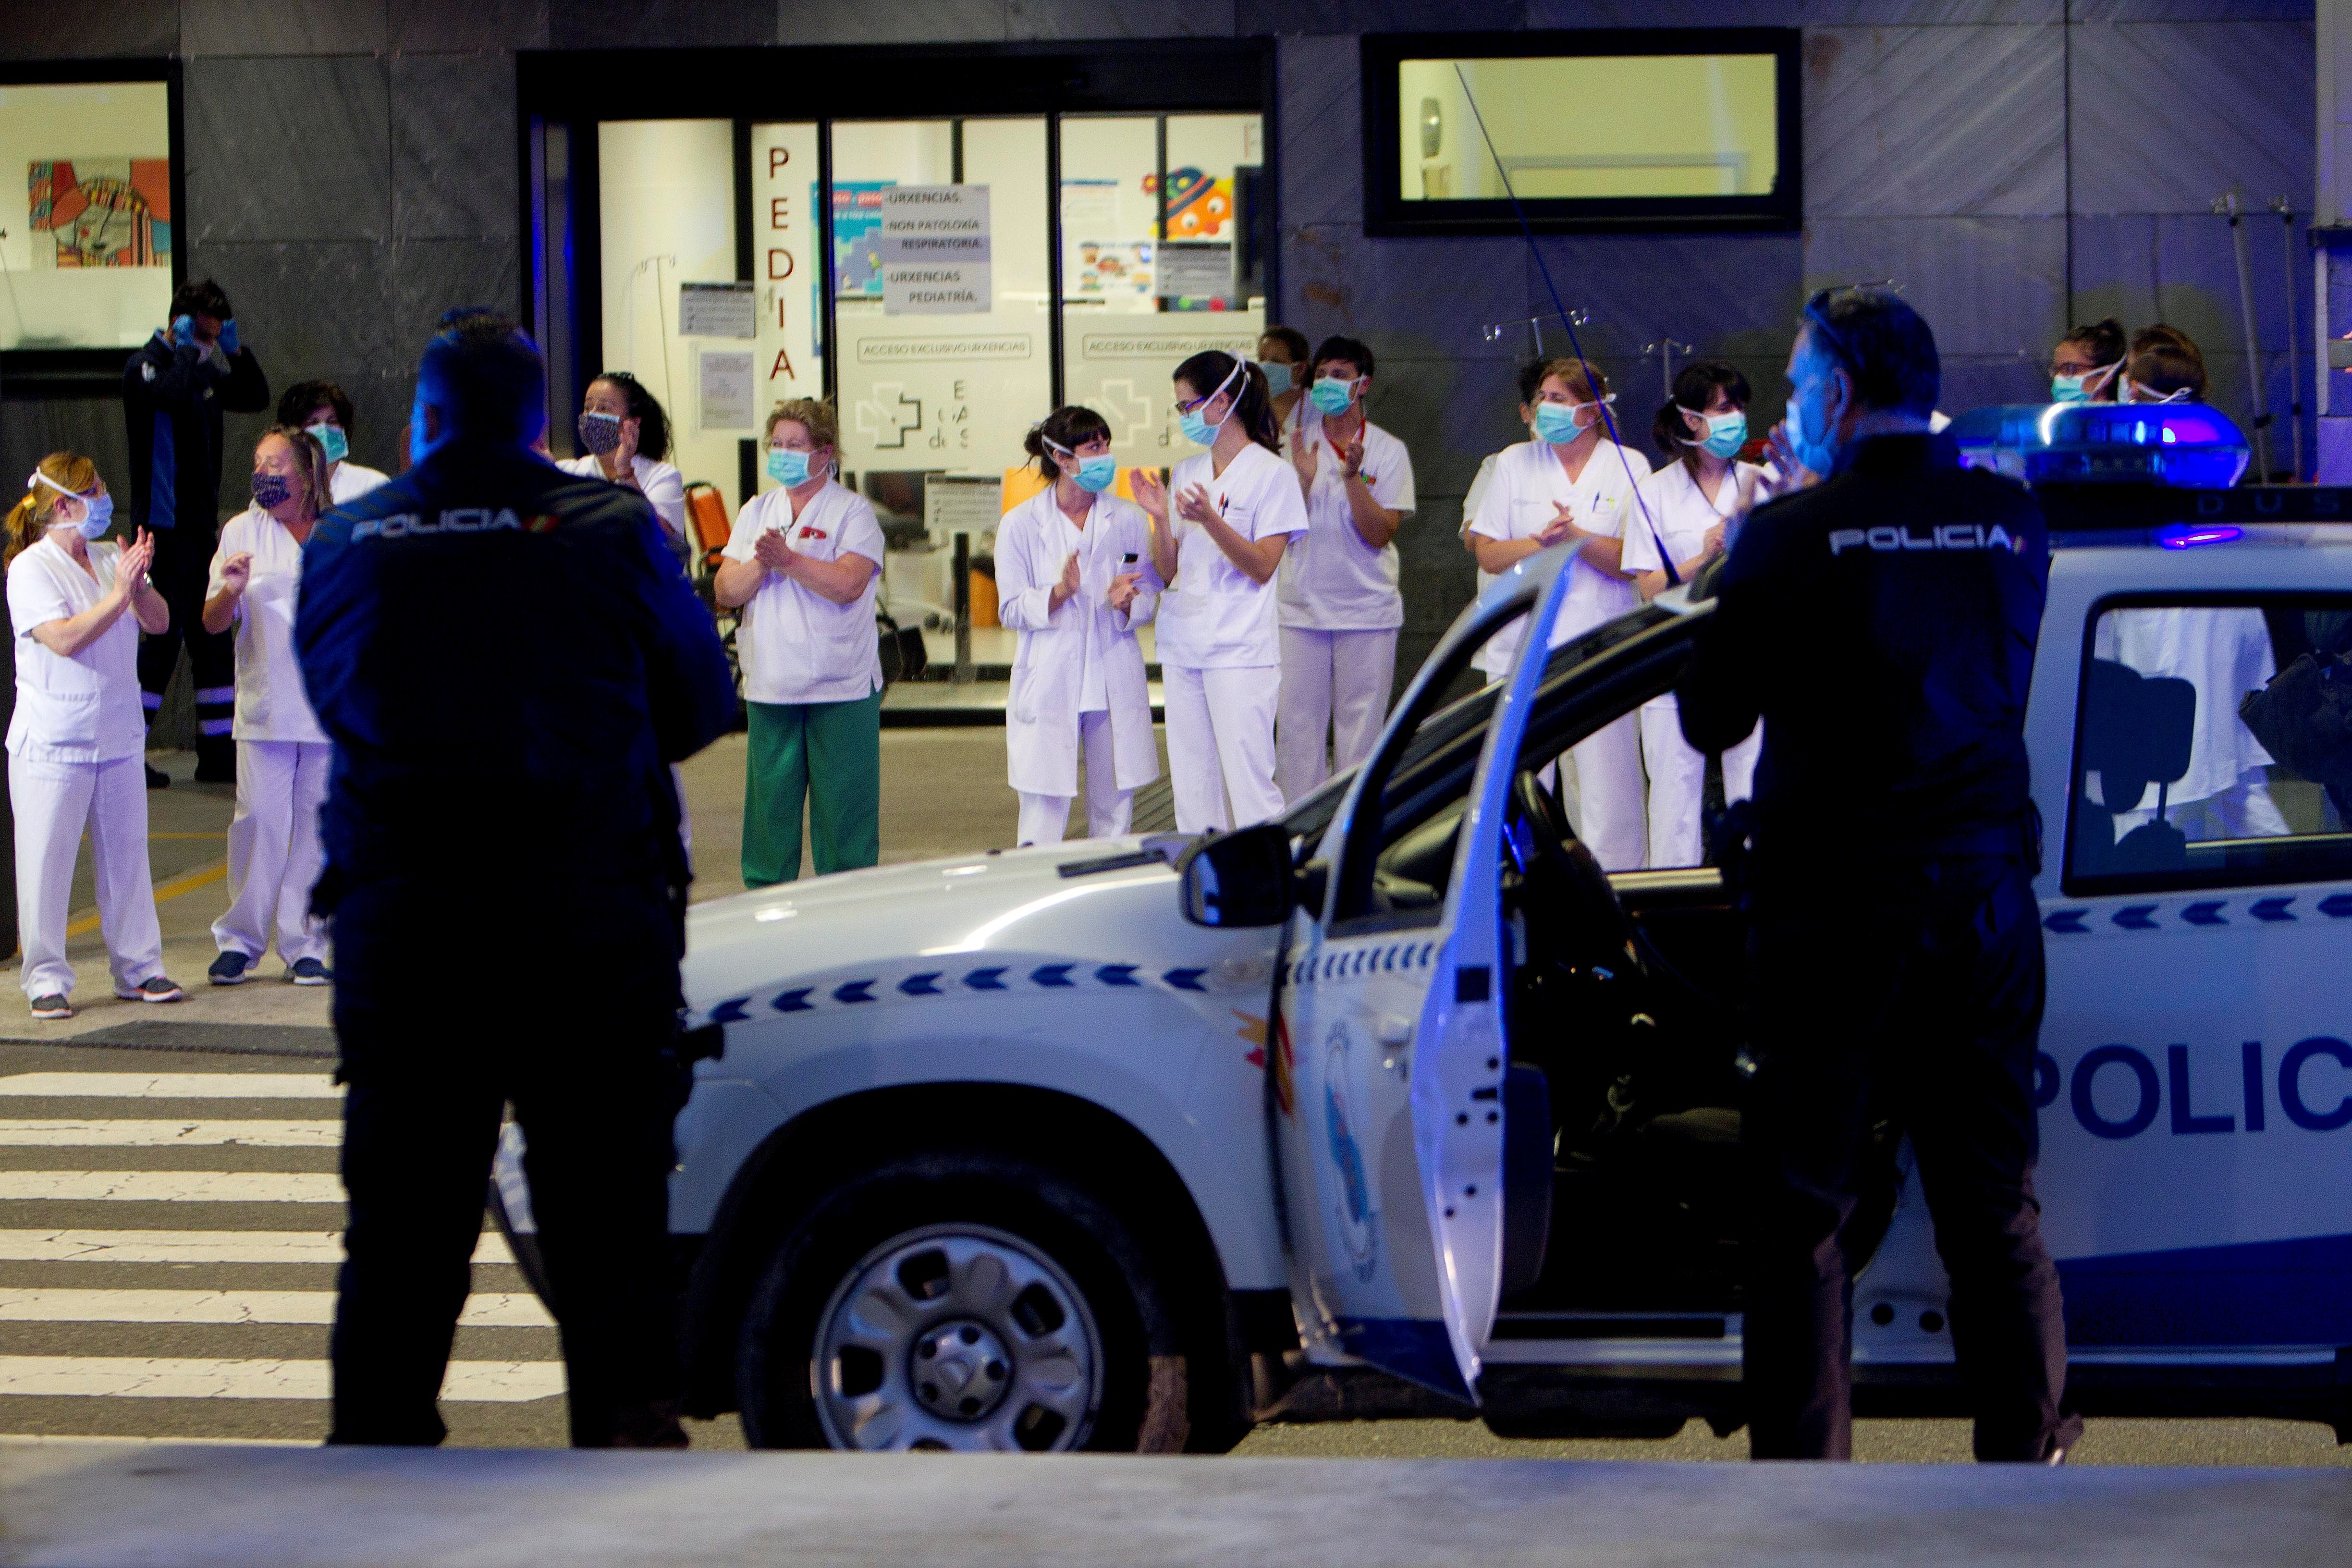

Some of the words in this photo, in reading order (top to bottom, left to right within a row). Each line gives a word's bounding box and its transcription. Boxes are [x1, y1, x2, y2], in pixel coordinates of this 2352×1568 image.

[918, 218, 979, 231] PATOLOXÍA
[768, 147, 796, 405] PEDIA
[351, 507, 522, 543] POLICIA
[1828, 523, 2012, 556] POLICIA
